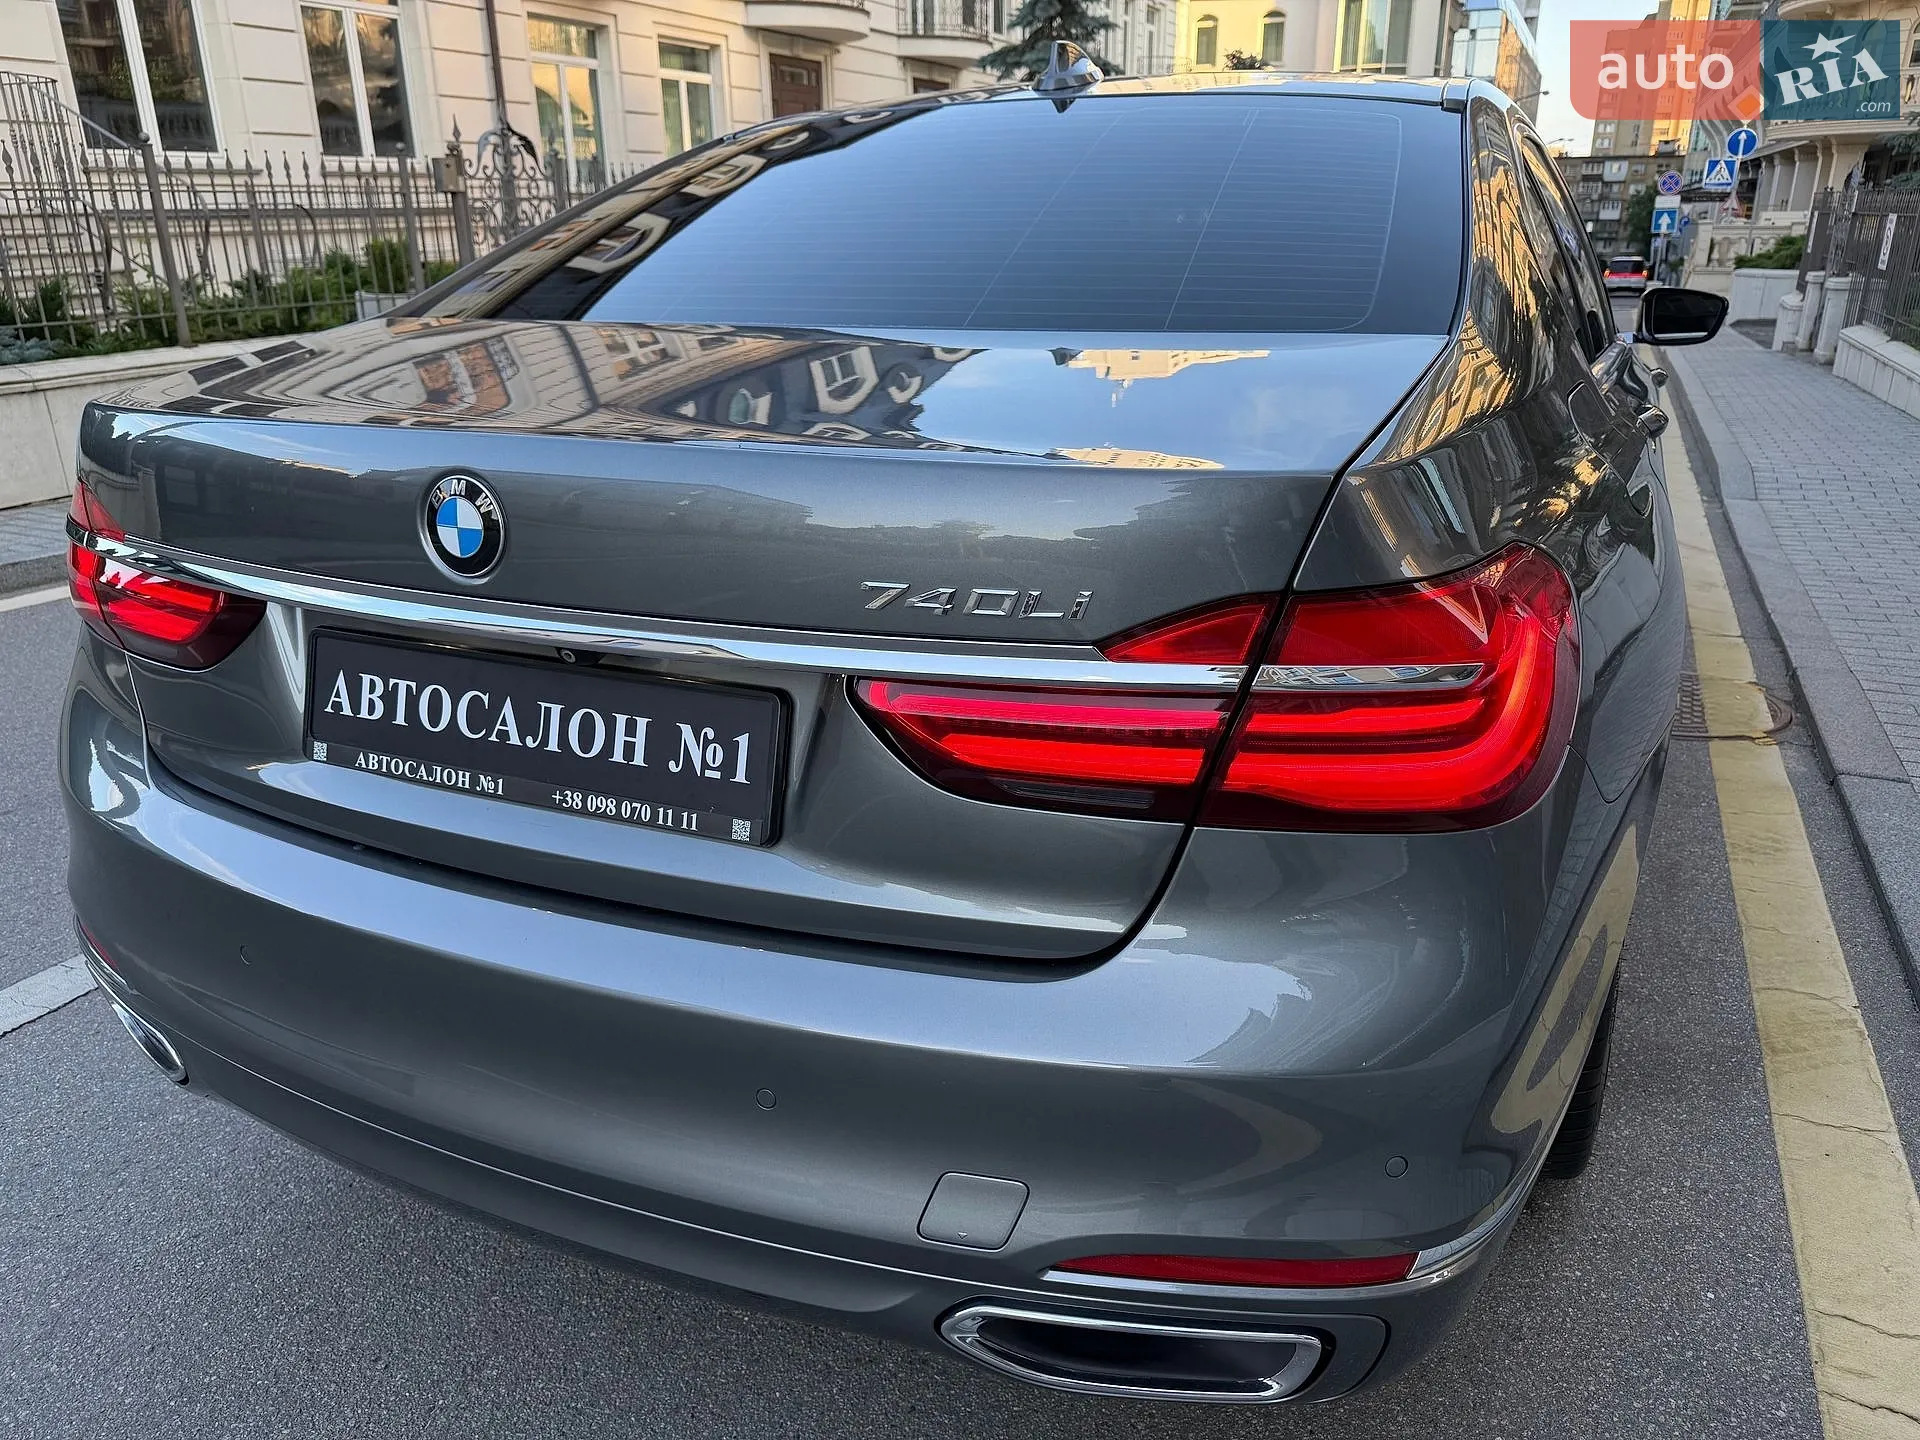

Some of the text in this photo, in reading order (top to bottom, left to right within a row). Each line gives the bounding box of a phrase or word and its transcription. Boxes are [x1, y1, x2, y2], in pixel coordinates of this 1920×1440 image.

[431, 479, 499, 520] BMW
[860, 581, 1093, 620] 740Li
[323, 669, 752, 785] АВТОСАЛОН №1
[354, 751, 505, 796] АВТОСАЛОН №1
[551, 789, 699, 831] +38 098 070 11 11
